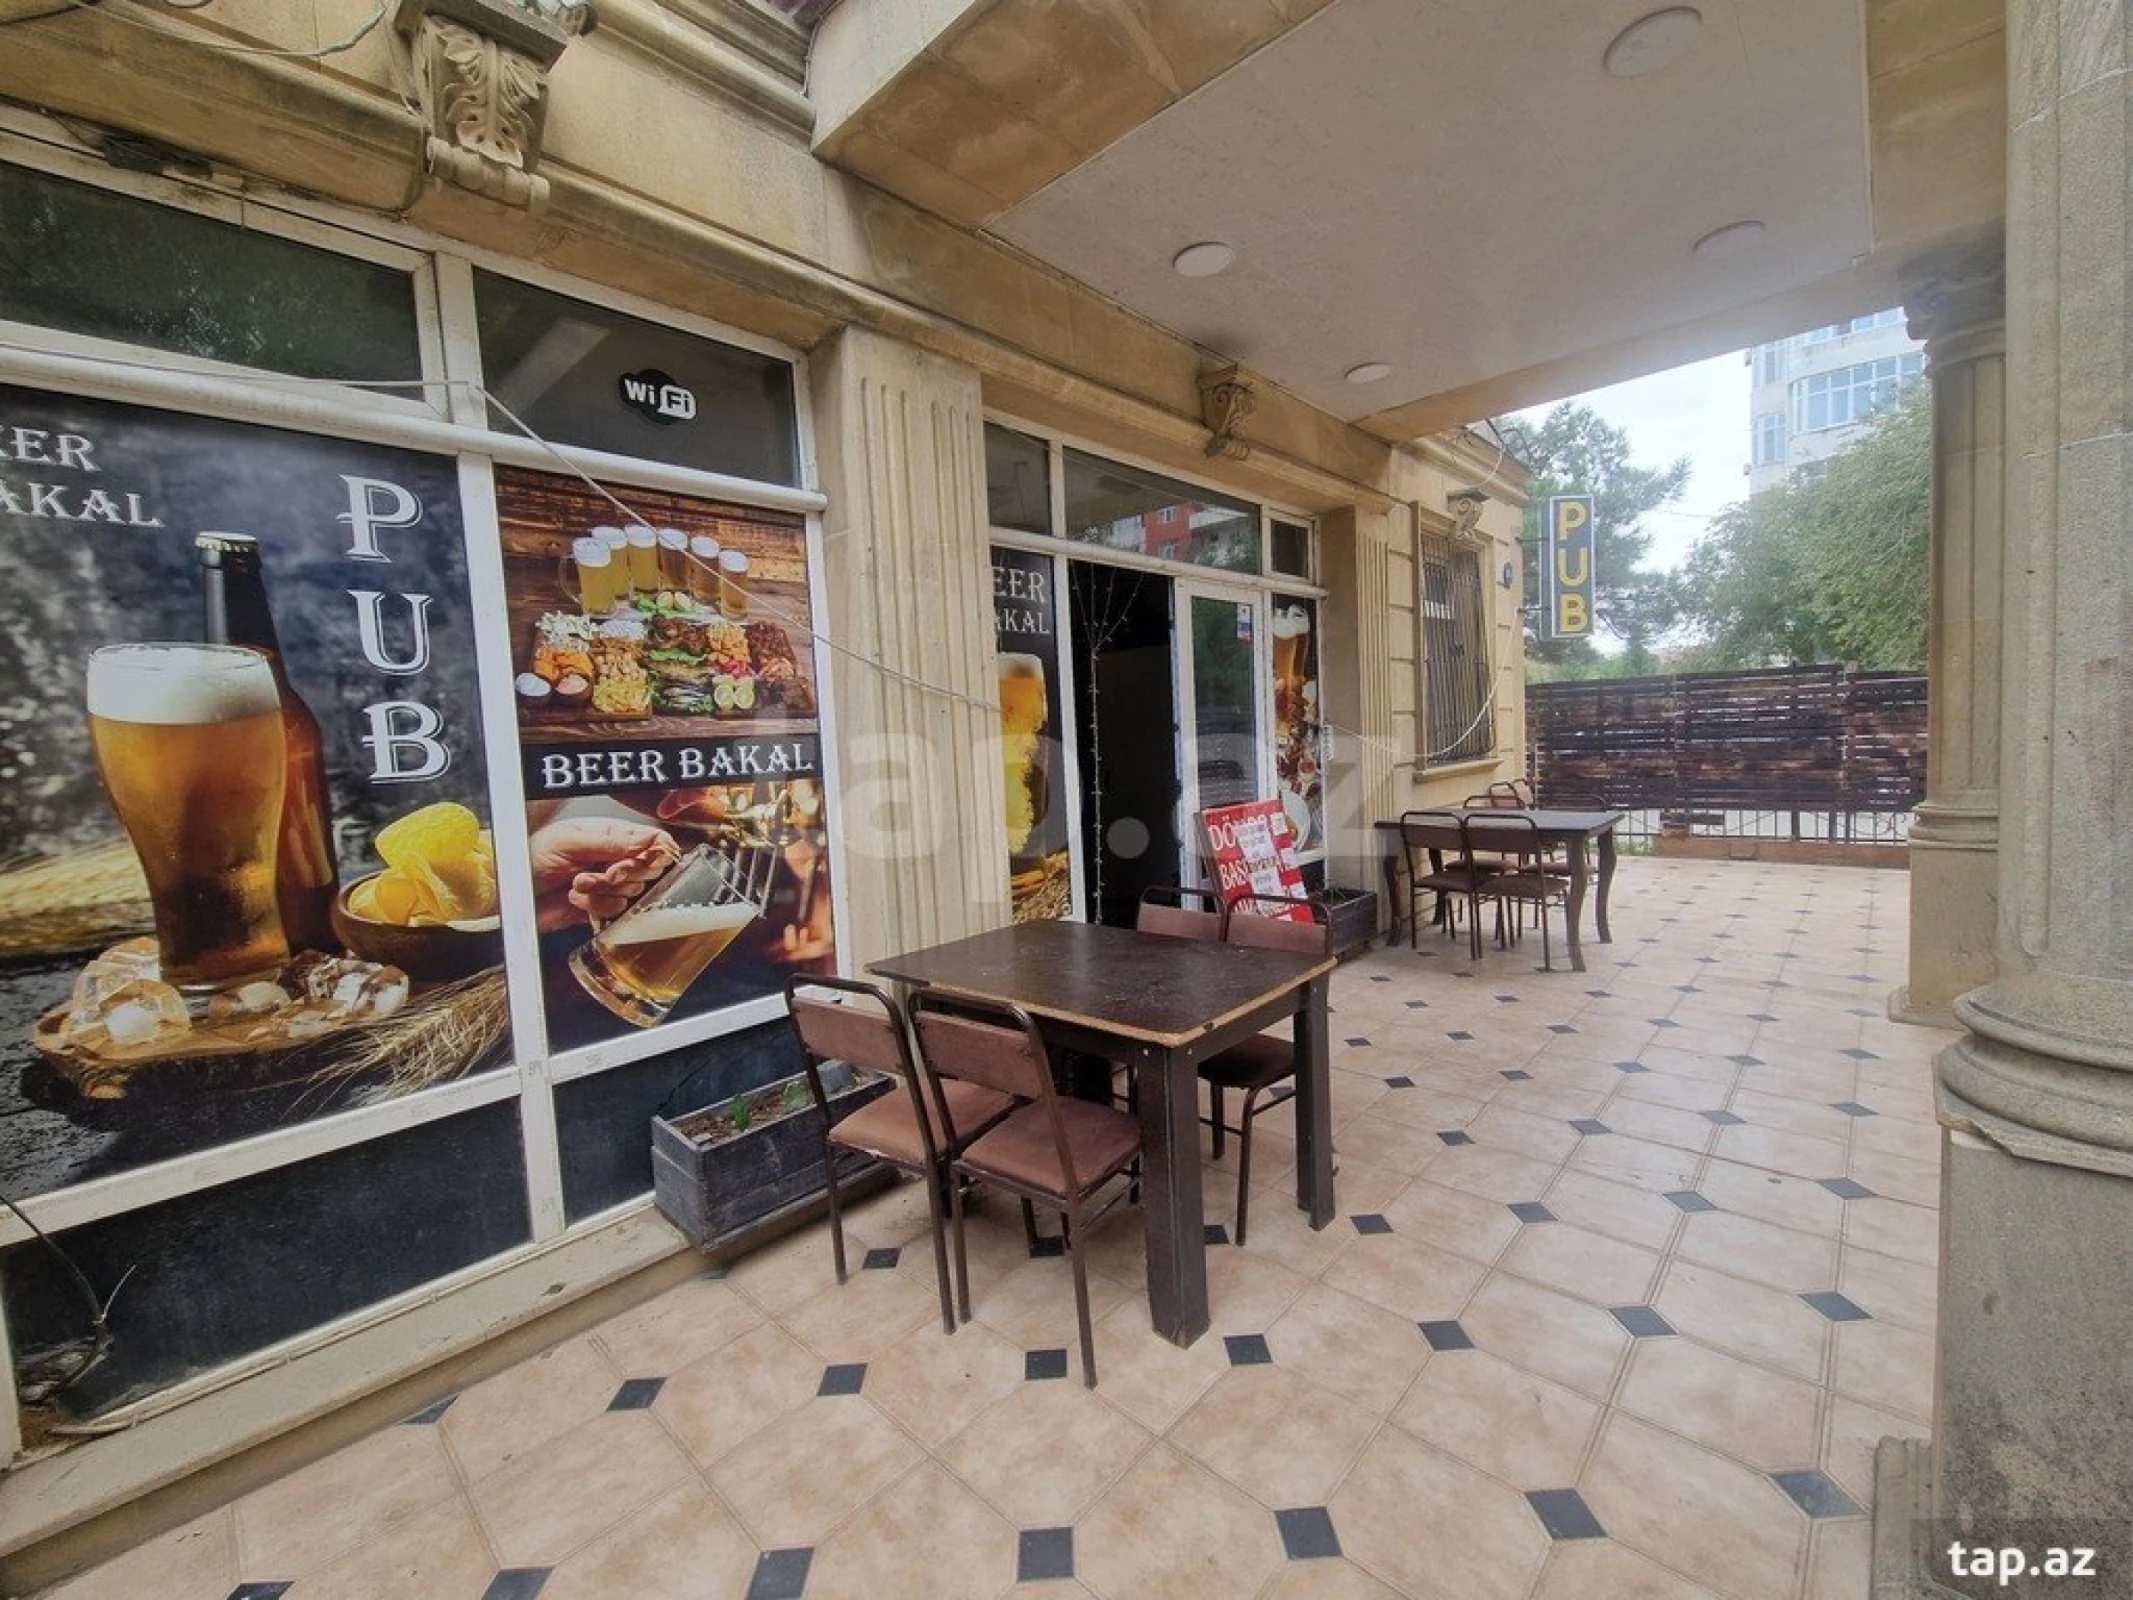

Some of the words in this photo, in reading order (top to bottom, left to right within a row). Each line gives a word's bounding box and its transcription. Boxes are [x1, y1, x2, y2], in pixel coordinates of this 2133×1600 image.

[336, 475, 452, 784] PUB
[1557, 501, 1589, 633] PUB
[542, 751, 668, 788] BEER
[678, 743, 813, 779] BAKAL
